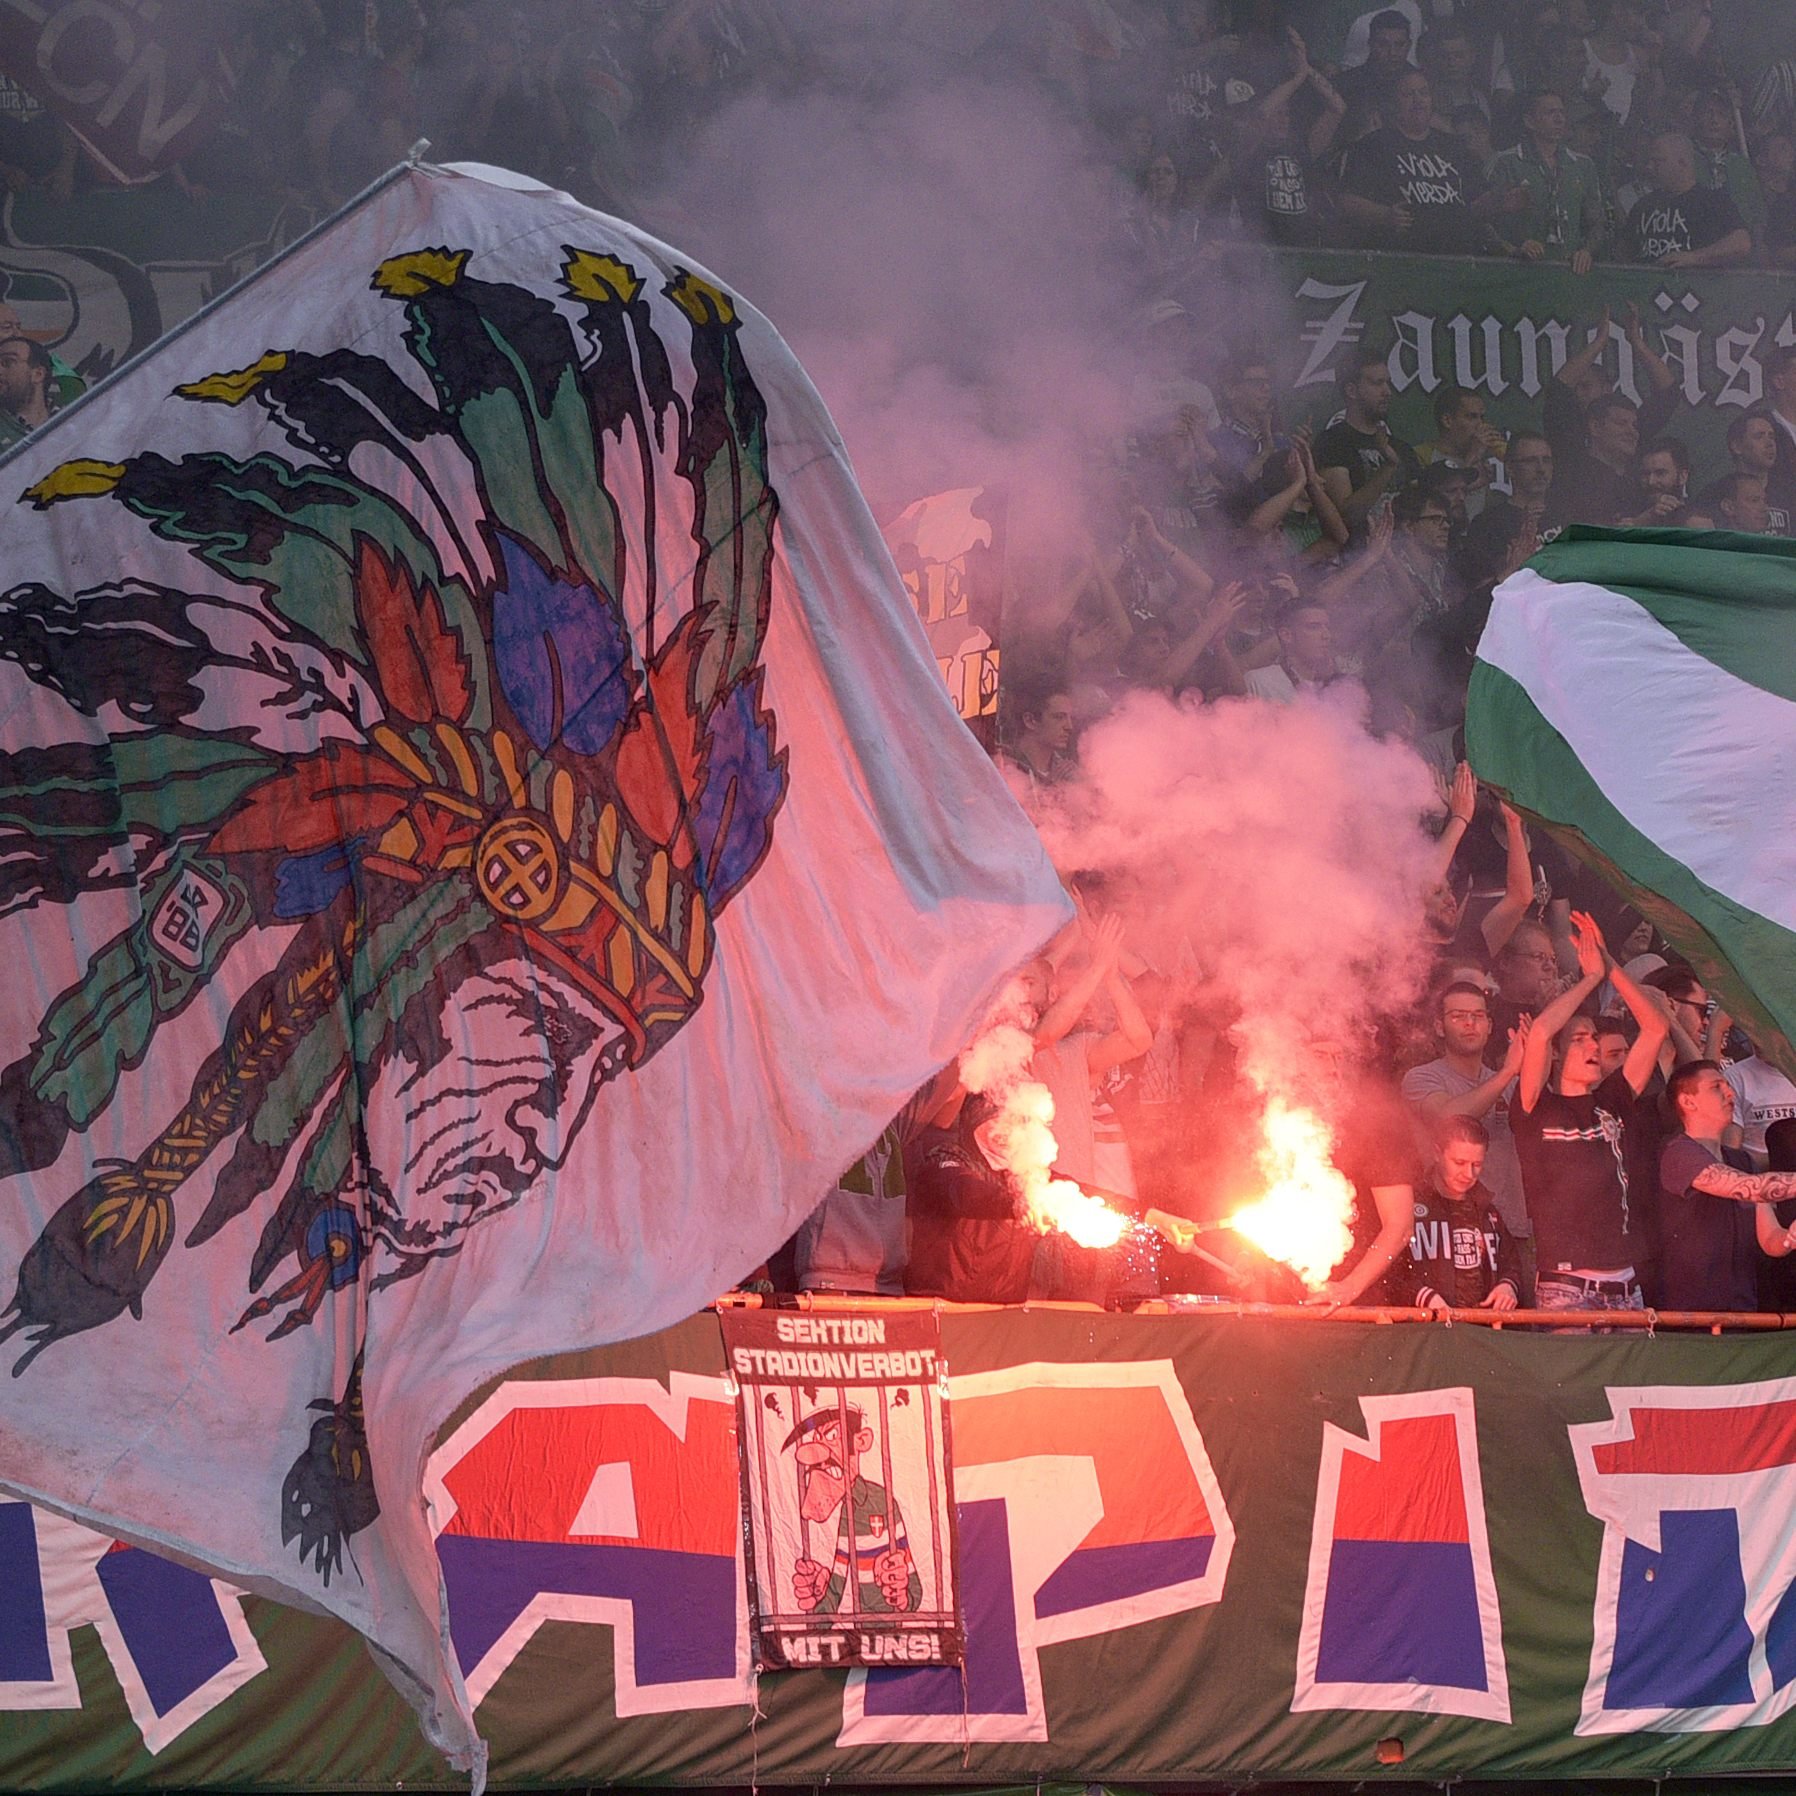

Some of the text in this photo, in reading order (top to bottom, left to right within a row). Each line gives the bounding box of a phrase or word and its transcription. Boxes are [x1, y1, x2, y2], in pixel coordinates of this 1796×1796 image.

[777, 1318, 886, 1344] SEKTION
[733, 1348, 936, 1379] STADIONVERBOT
[781, 1634, 941, 1662] MIT UNS!
